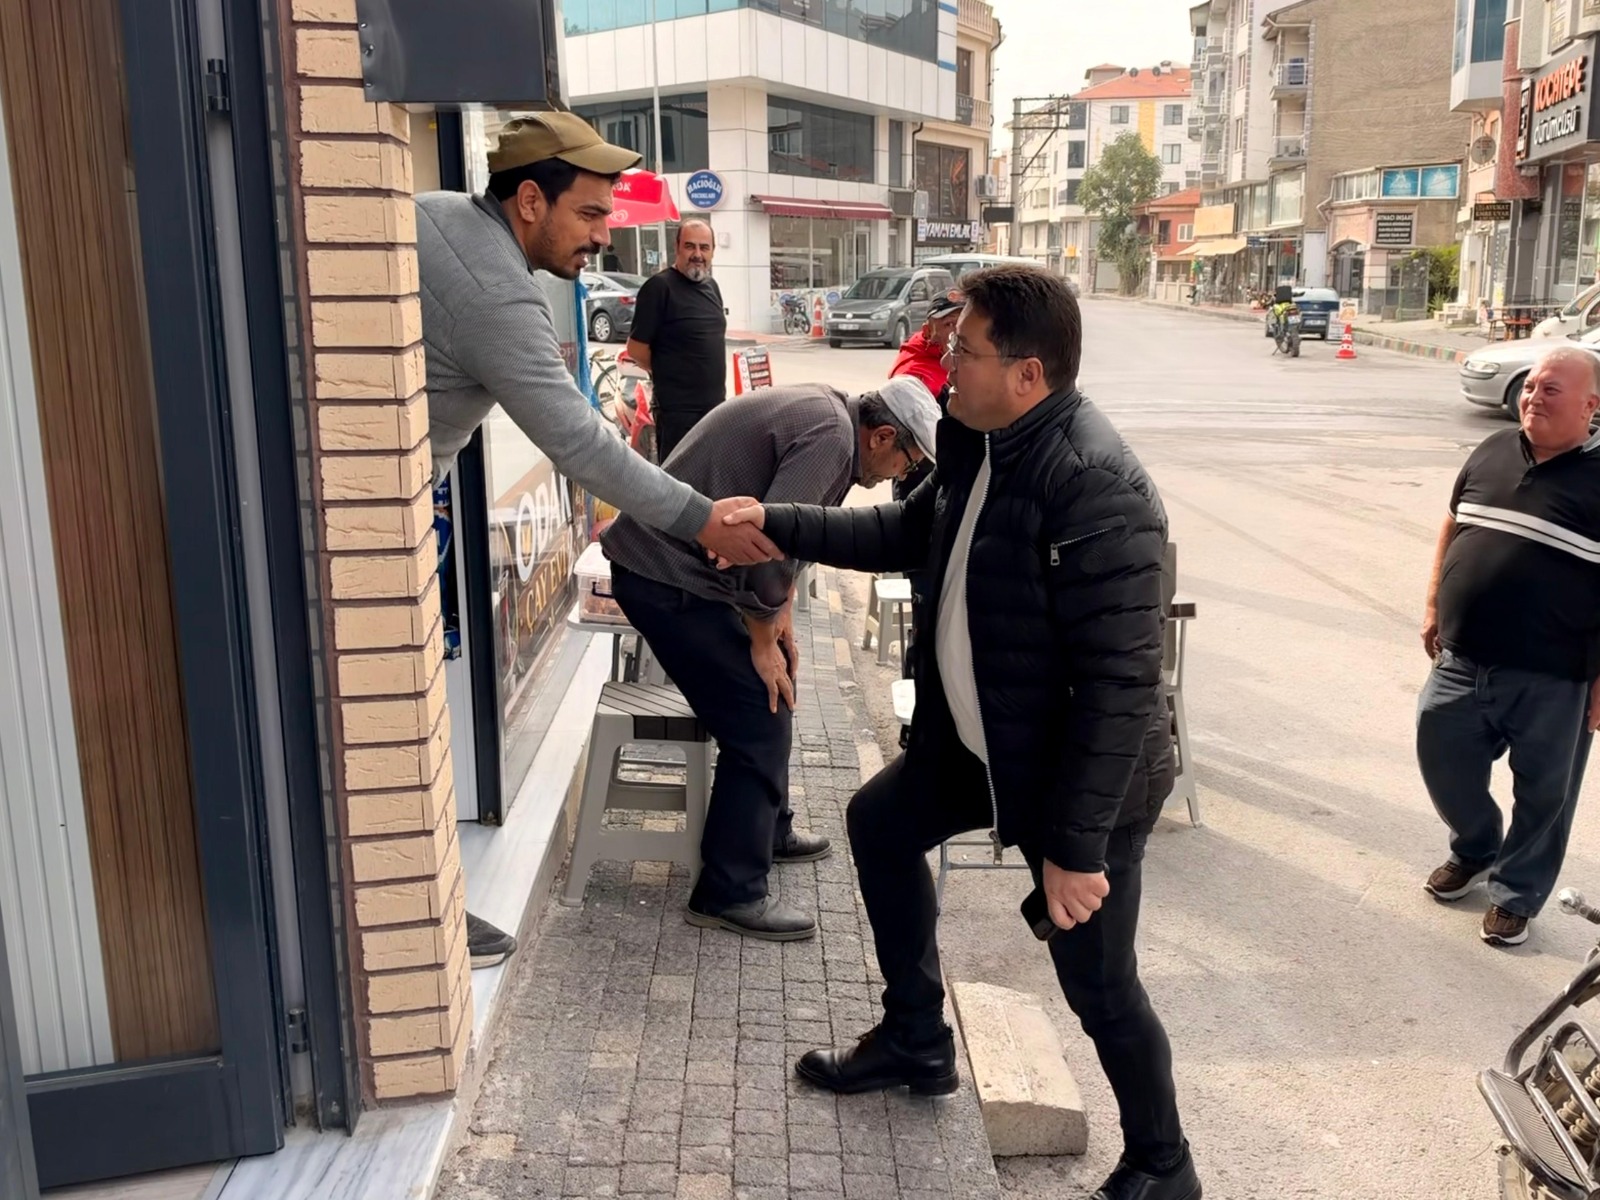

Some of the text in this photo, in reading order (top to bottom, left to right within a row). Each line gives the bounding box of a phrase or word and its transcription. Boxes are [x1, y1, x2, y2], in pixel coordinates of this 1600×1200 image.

[1534, 55, 1584, 112] KOCATEPE
[927, 222, 950, 238] YAMAN
[949, 224, 971, 238] EMLAK
[526, 567, 548, 638] ÇAY
